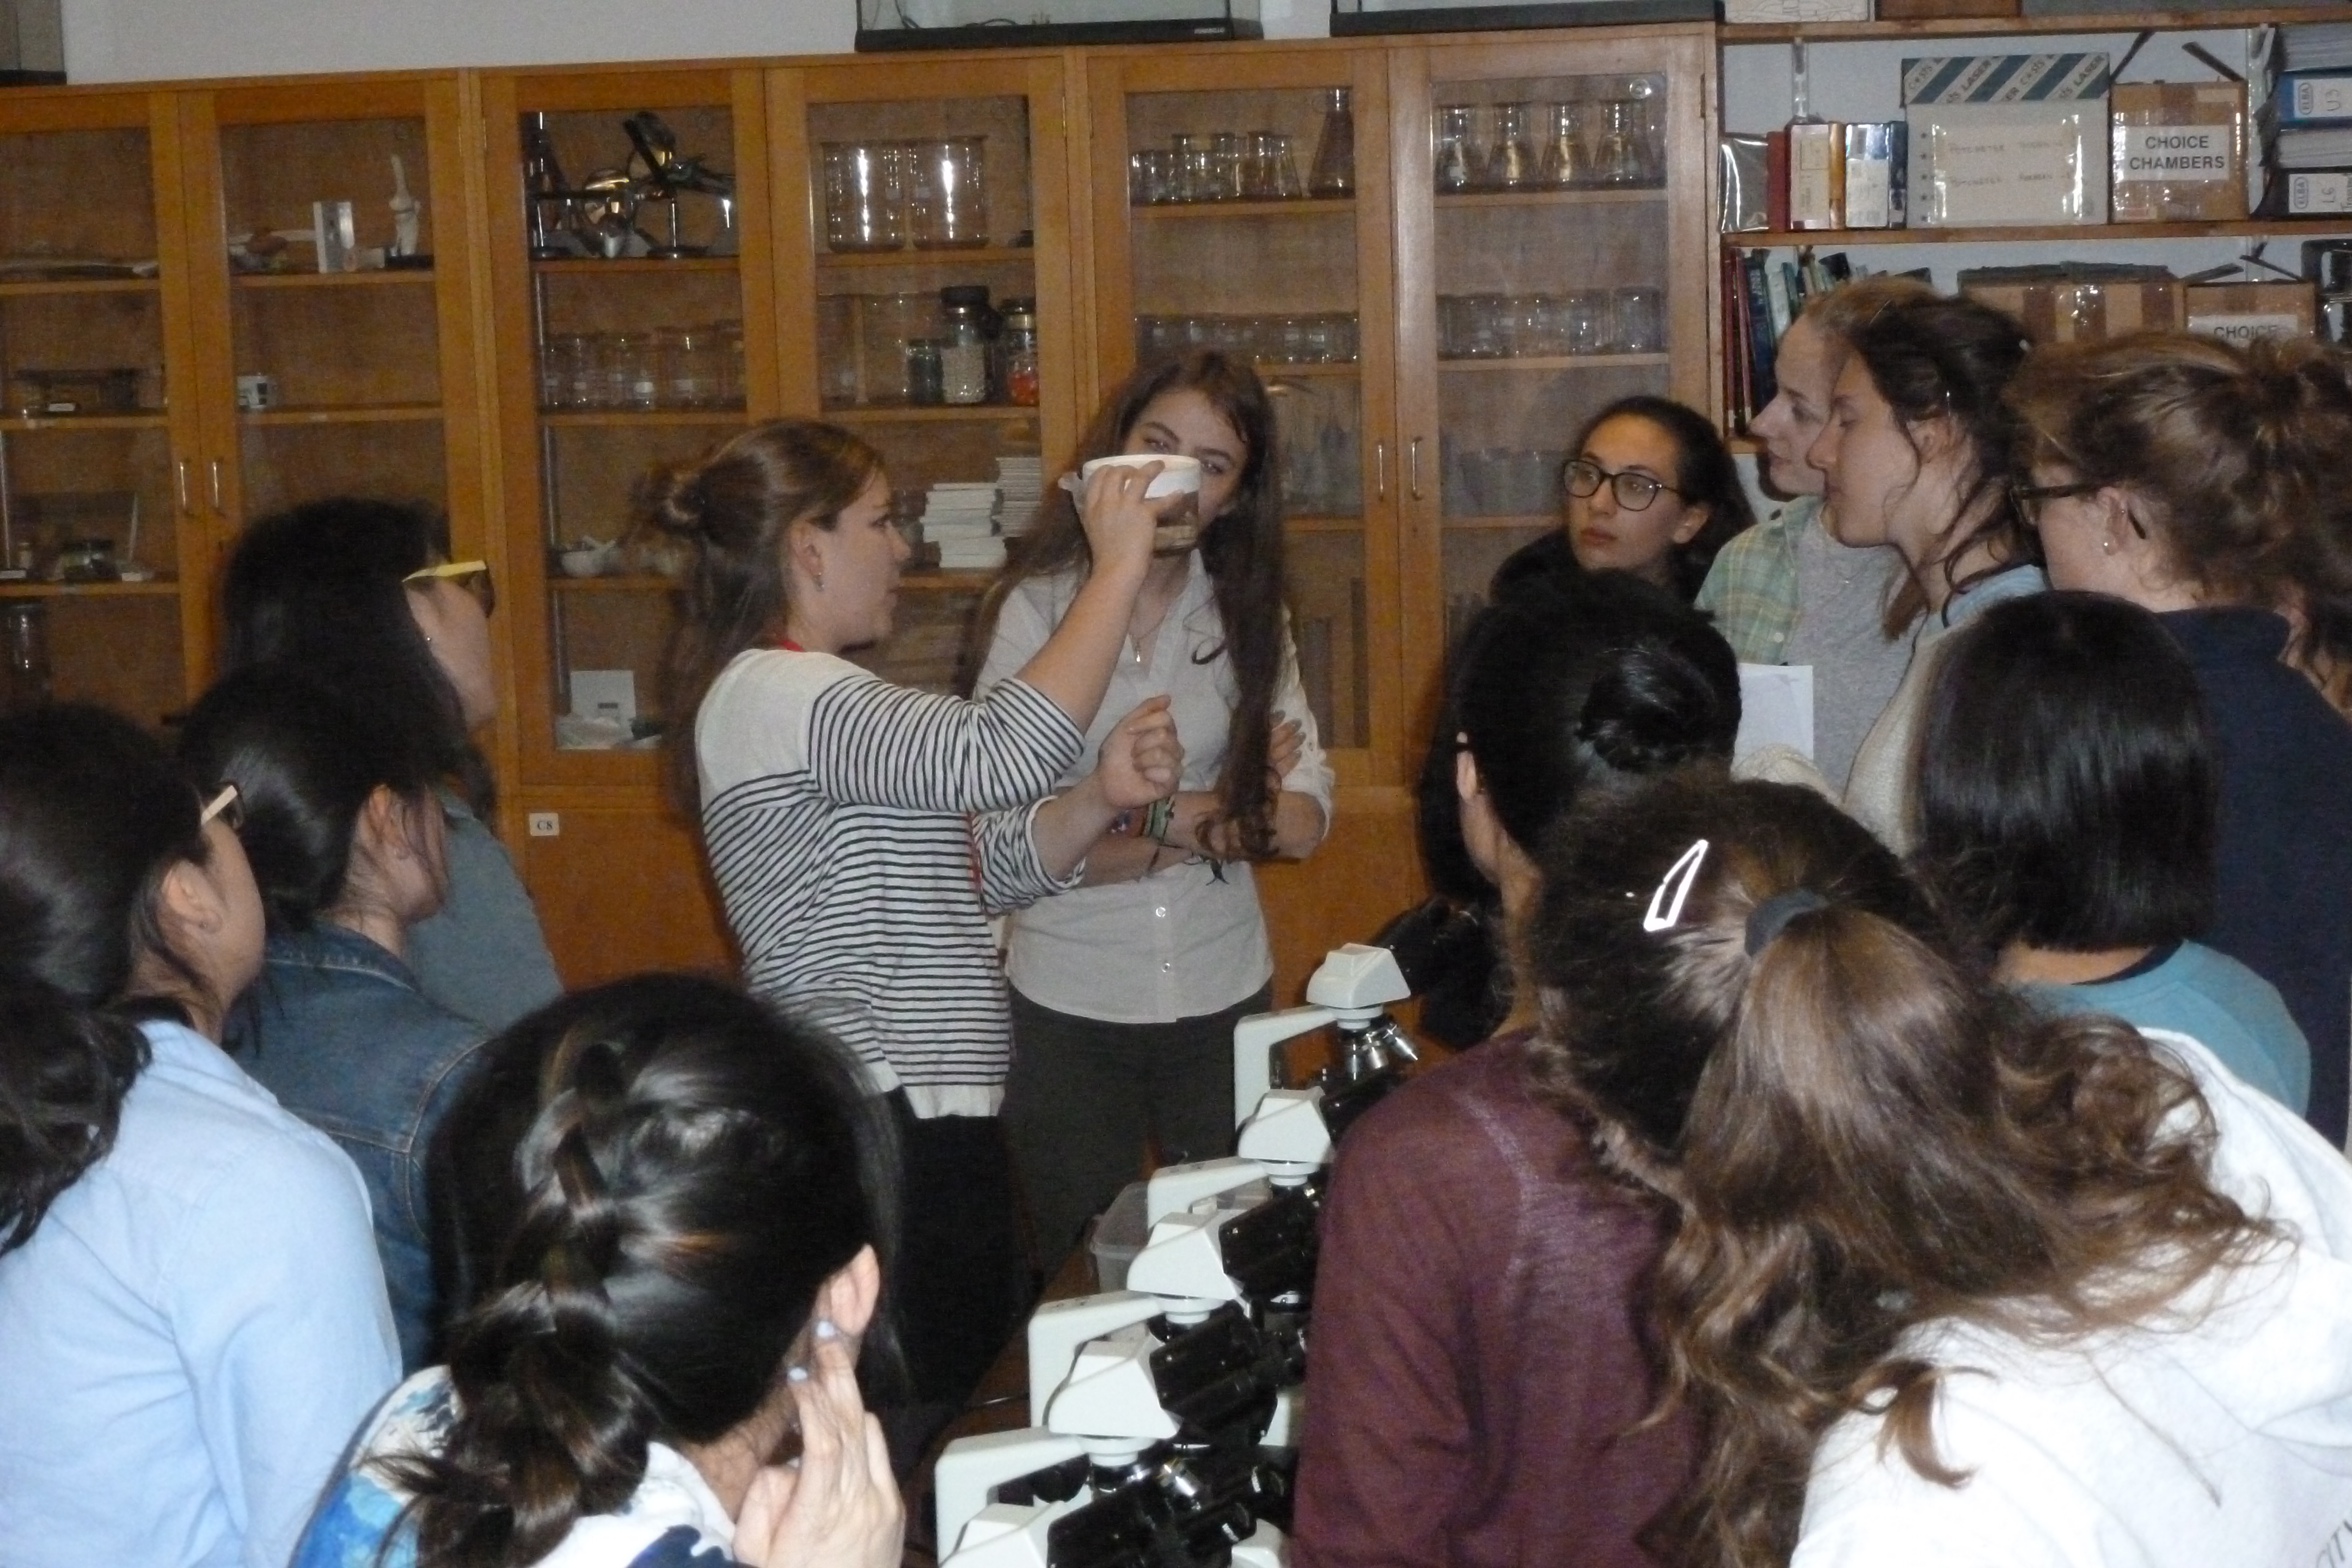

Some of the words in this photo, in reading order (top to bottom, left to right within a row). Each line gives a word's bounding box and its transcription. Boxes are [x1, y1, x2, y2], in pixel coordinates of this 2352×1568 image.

[2145, 136, 2209, 150] CHOICE
[2129, 156, 2225, 170] CHAMBERS
[537, 820, 553, 831] C8
